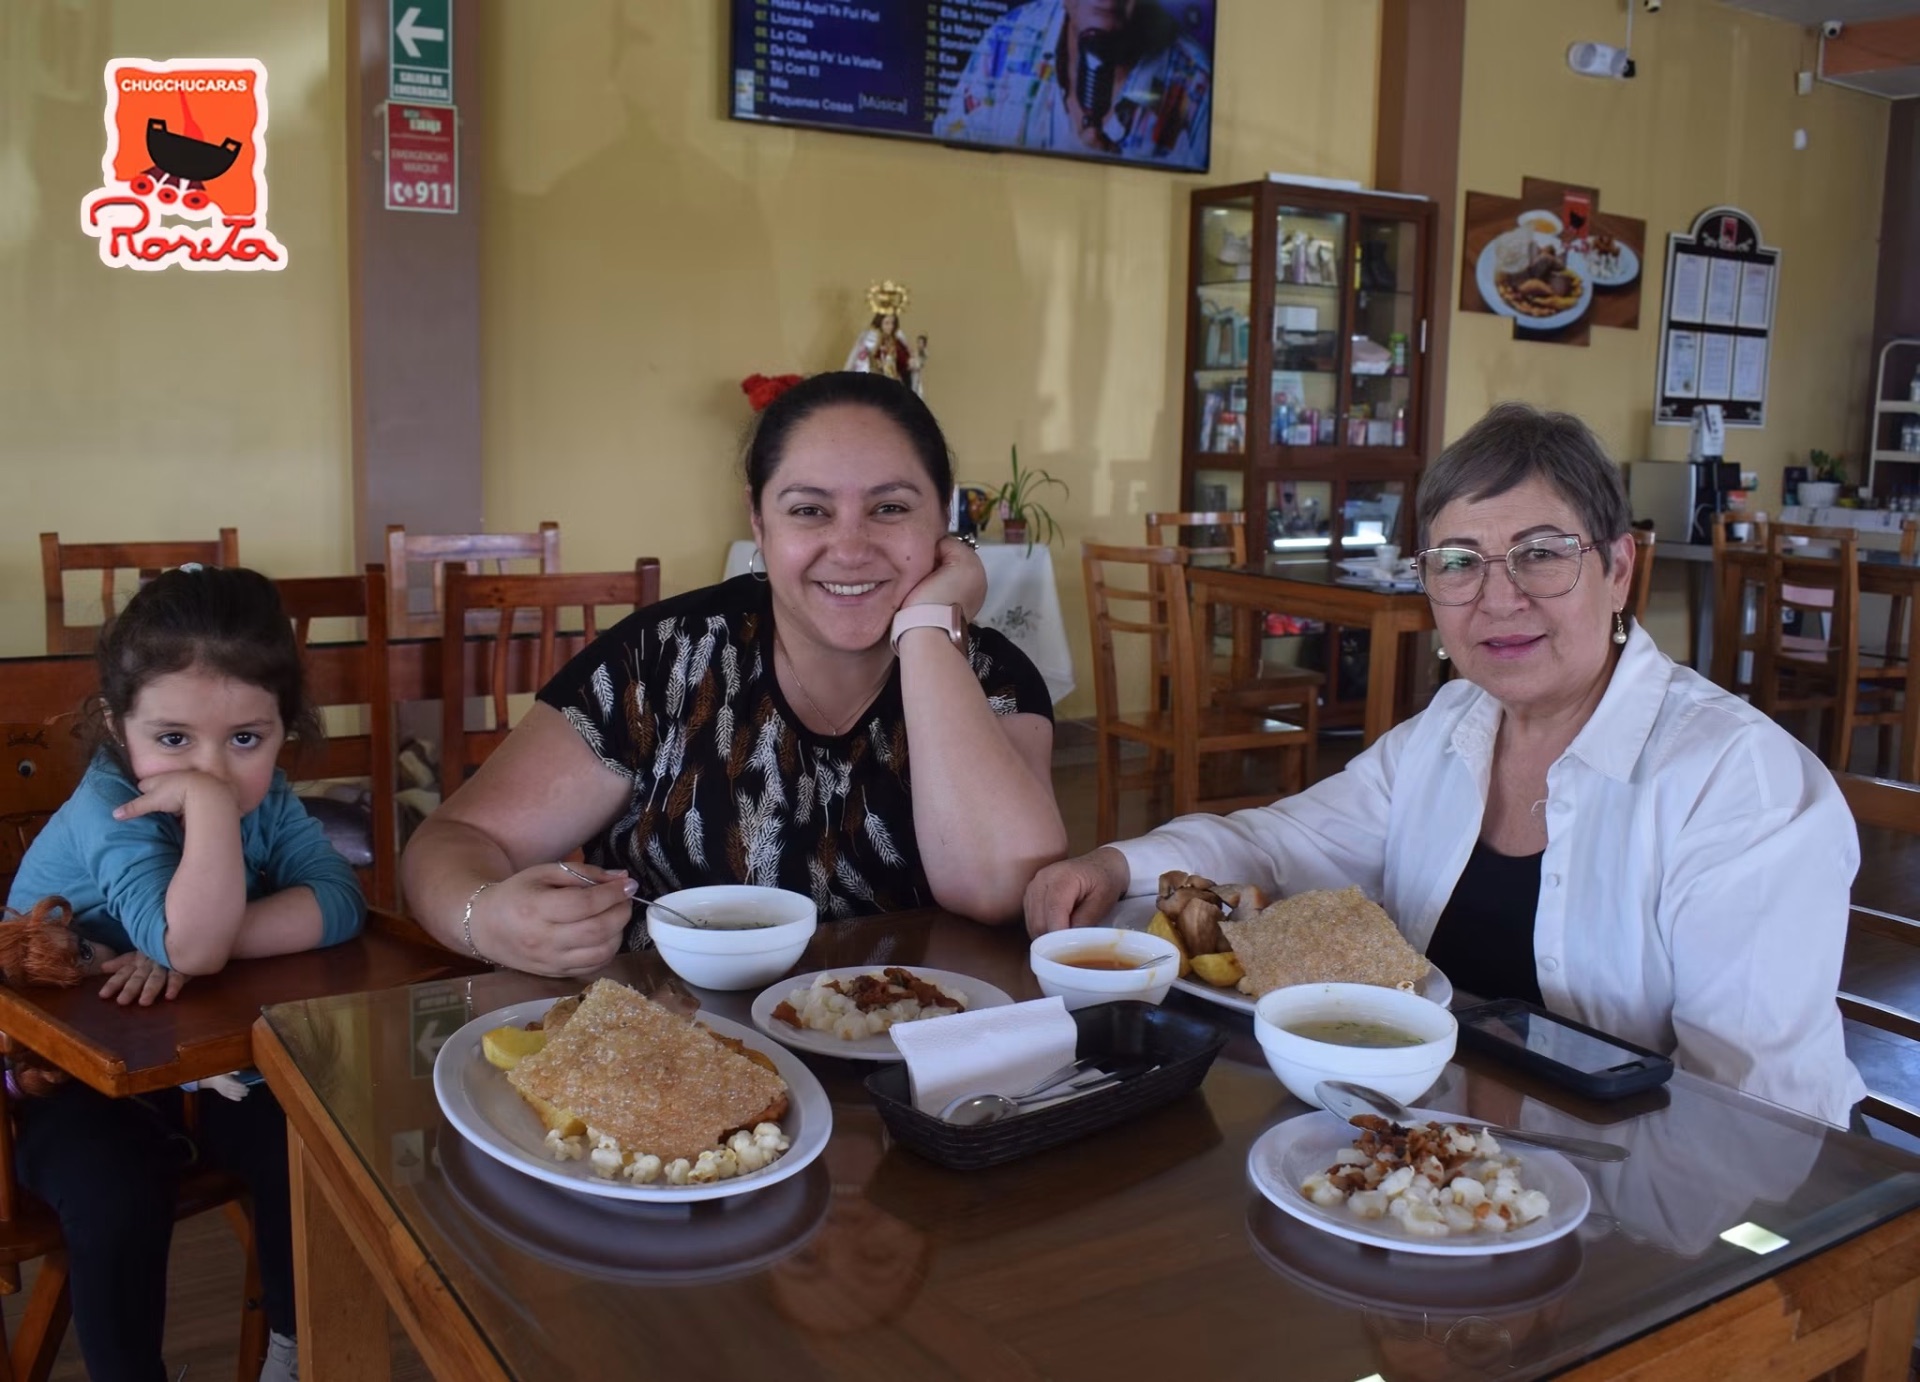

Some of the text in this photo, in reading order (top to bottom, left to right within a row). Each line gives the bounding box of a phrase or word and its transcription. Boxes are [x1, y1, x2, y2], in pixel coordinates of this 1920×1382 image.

[770, 28, 784, 41] La
[786, 30, 807, 43] Cita
[770, 44, 785, 56] De
[787, 46, 818, 61] Vuelta
[838, 54, 851, 66] La
[852, 55, 883, 70] Vuelta
[785, 62, 807, 75] Con
[822, 99, 854, 113] Cosas
[415, 180, 451, 205] 911
